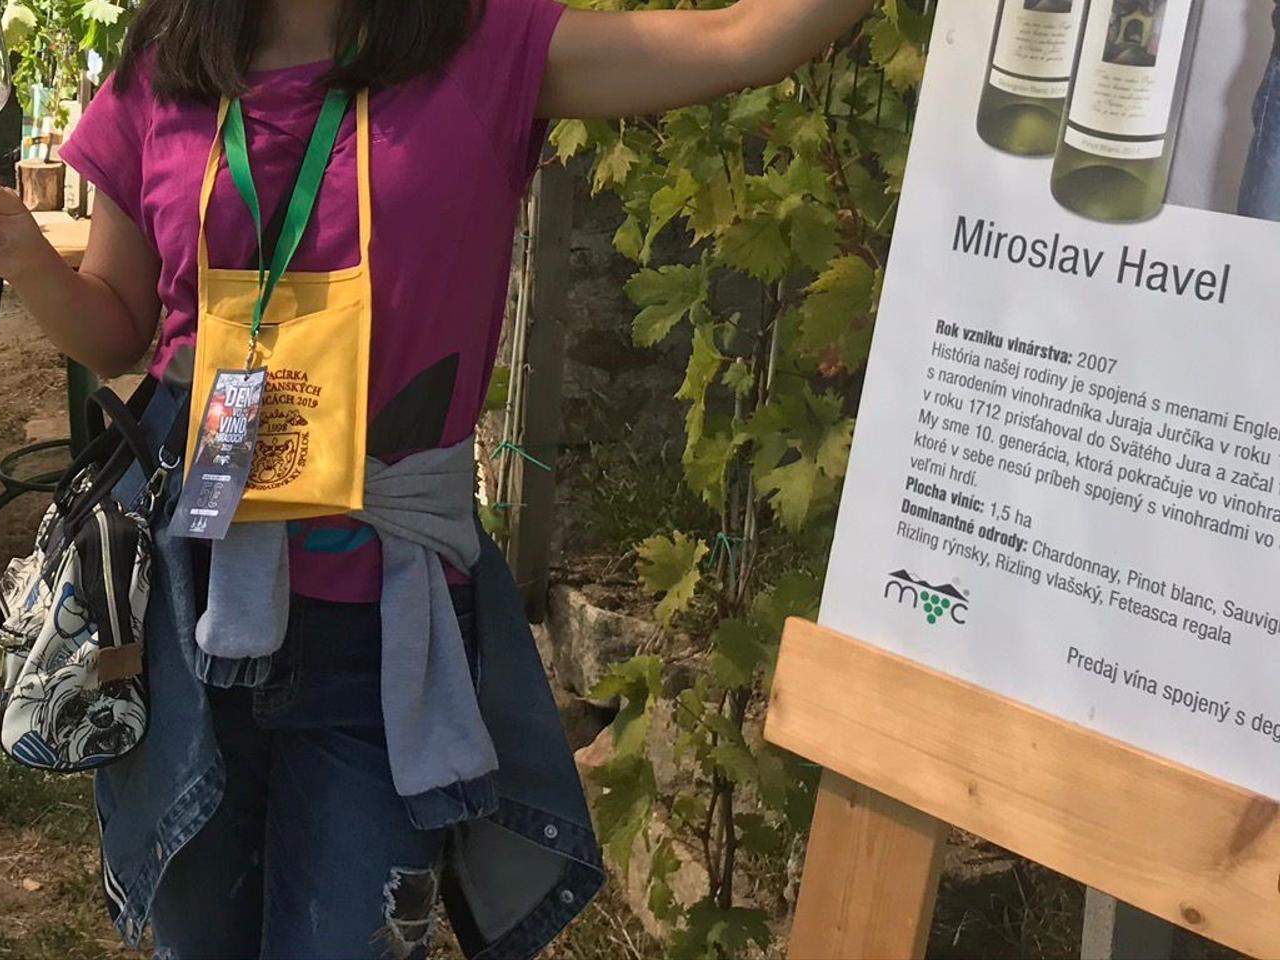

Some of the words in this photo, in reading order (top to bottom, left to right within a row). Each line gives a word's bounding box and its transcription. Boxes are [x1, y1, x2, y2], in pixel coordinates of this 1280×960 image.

[952, 215, 1105, 279] Miroslav
[1116, 245, 1231, 305] Havel
[931, 340, 981, 368] História
[983, 356, 1022, 381] našej
[1023, 366, 1069, 392] rodiny
[1068, 374, 1086, 395] je
[1087, 382, 1148, 410] spojená
[1150, 398, 1162, 412] s
[1164, 401, 1229, 429] menami
[1232, 413, 1280, 441] Engle
[935, 318, 960, 339] Rok
[962, 327, 1004, 349] vzniku
[1007, 336, 1074, 366] vinárstva:
[1076, 351, 1118, 375] 2007
[296, 396, 319, 408] 2019
[923, 388, 932, 402] v
[933, 391, 964, 411] roku
[968, 397, 1003, 421] 1712
[1003, 410, 1084, 444] prisťahoval
[1086, 429, 1106, 449] do
[1109, 434, 1172, 467] Svätého
[1175, 453, 1212, 478] Jura
[1215, 466, 1227, 482] a
[1229, 470, 1274, 494] začal
[926, 366, 935, 380] s
[937, 369, 1008, 399] narodením
[1011, 385, 1103, 423] vinohradníka
[1105, 409, 1153, 437] Juraja
[1156, 421, 1215, 452] Jurčíka
[1219, 440, 1231, 455] v
[1233, 444, 1272, 466] roku
[904, 475, 948, 503] Plocha
[950, 490, 985, 515] viníc:
[990, 501, 1012, 522] 1,5
[1013, 508, 1033, 529] ha
[910, 456, 948, 478] veľmi
[948, 463, 978, 488] hrdí.
[913, 430, 948, 454] ktoré
[950, 443, 960, 457] v
[961, 447, 995, 468] sebe
[997, 457, 1033, 479] nesú
[1034, 468, 1081, 493] príbeh
[1083, 482, 1144, 513] spojený
[1146, 500, 1157, 515] s
[1161, 502, 1251, 541] vinohradmi
[1254, 530, 1274, 548] vo
[917, 407, 940, 431] My
[941, 417, 971, 437] sme
[975, 423, 995, 444] 10.
[997, 433, 1071, 468] generácia,
[1074, 450, 1114, 477] ktorá
[1116, 466, 1194, 500] pokračuje
[1197, 487, 1218, 506] vo
[896, 520, 940, 551] Rizling
[941, 537, 991, 568] rýnsky,
[994, 552, 1043, 586] Rizling
[1045, 571, 1104, 606] vlašský,
[1108, 589, 1179, 629] Feteasca
[1182, 616, 1232, 646] regala
[900, 497, 975, 536] Dominantné
[977, 525, 1029, 553] odrody:
[1031, 539, 1122, 586] Chardonnay,
[1126, 569, 1167, 598] Pinot
[1169, 582, 1217, 617] blanc,
[1222, 599, 1280, 636] Sauvig
[1066, 646, 1119, 685] Predaj
[1122, 669, 1158, 696] vína
[1161, 684, 1231, 724] spojený
[1234, 709, 1247, 727] s
